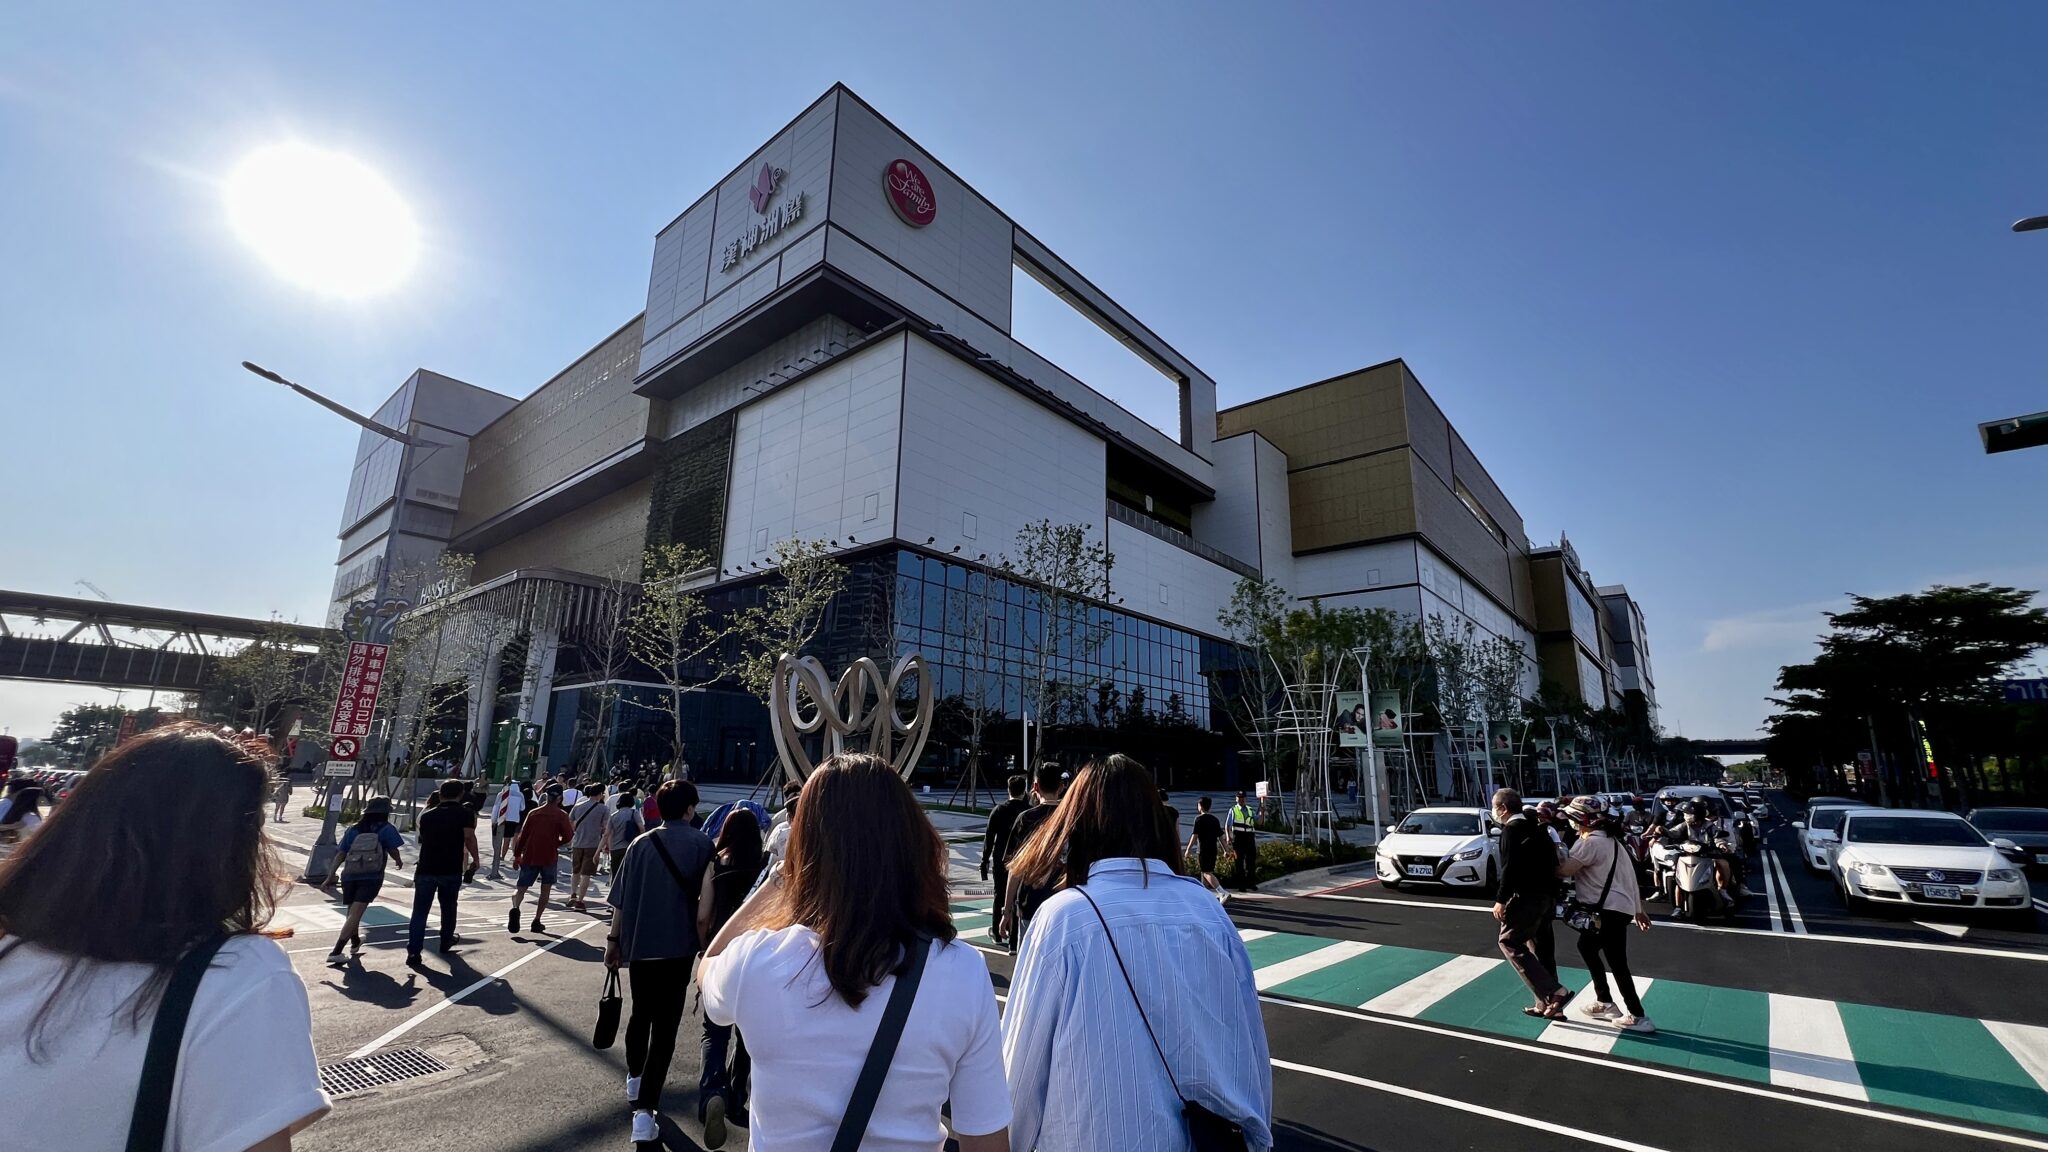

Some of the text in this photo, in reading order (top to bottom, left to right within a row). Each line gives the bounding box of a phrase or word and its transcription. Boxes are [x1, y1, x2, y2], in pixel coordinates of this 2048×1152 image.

[720, 190, 805, 273] 漢神洲際
[889, 174, 936, 214] Family
[333, 643, 369, 734] 請勿排隊以免受罰
[352, 645, 386, 735] 停車場車位已滿
